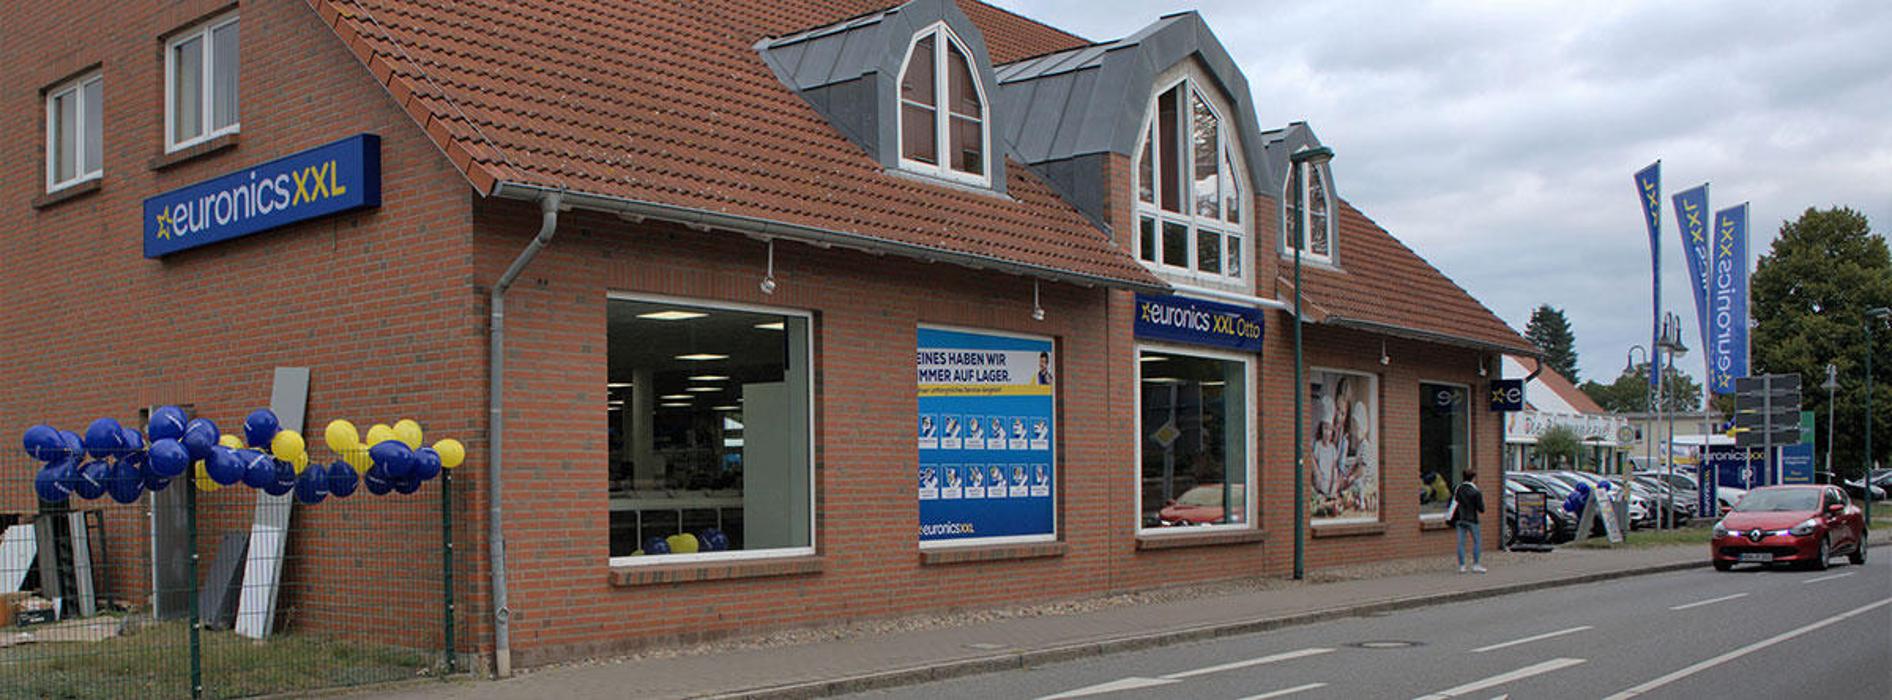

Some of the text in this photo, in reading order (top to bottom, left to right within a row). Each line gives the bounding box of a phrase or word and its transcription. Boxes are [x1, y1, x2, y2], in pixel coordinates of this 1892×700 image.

[1150, 303, 1260, 339] euronics XXL Otto
[948, 352, 984, 366] HABEN
[985, 353, 1006, 366] WIR
[953, 368, 973, 382] AUF
[976, 369, 1012, 383] LAGER.
[1506, 387, 1521, 403] e
